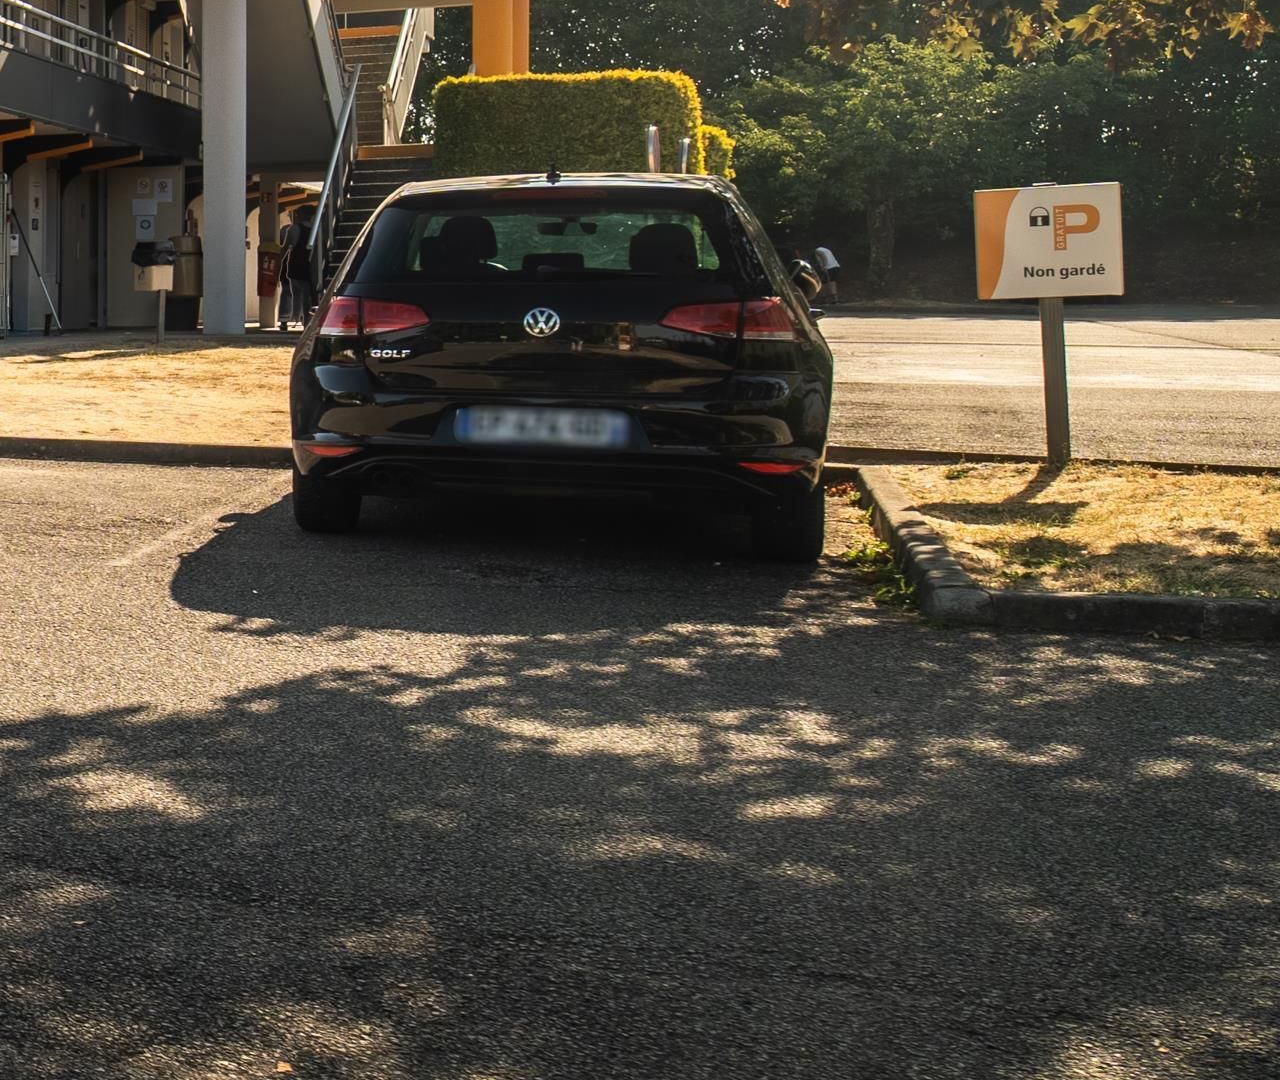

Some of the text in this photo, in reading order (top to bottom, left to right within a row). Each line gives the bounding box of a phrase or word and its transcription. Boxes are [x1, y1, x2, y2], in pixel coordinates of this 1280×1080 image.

[1053, 204, 1100, 250] P
[1055, 209, 1065, 249] GRATUIT
[1024, 263, 1105, 280] Non gardé
[370, 349, 411, 358] GOLF
